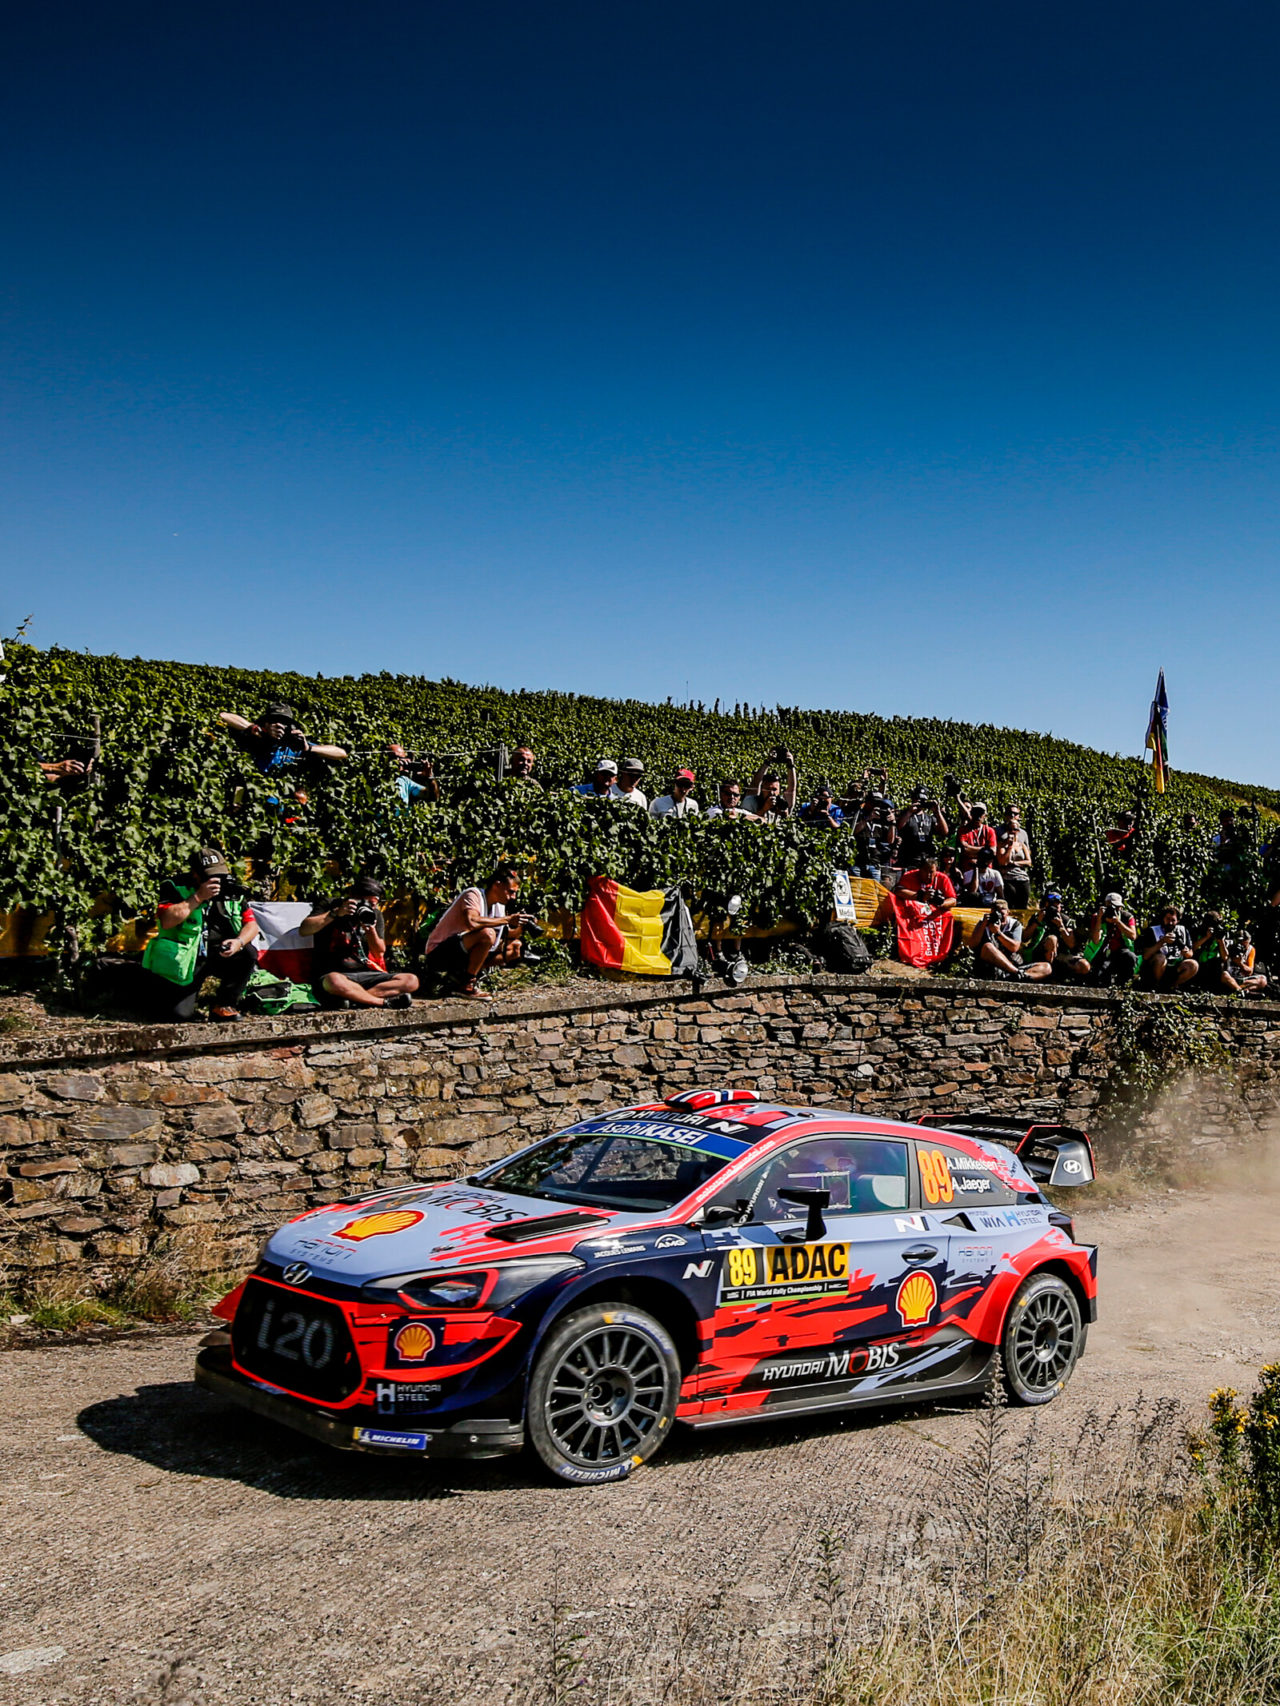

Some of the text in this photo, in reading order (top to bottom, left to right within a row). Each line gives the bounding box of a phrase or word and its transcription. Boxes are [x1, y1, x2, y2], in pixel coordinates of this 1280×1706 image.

[632, 1109, 708, 1126] HYUNDAI
[592, 1121, 708, 1146] AsahiKASEI
[946, 1157, 999, 1171] A.Mikkelsen
[917, 1149, 954, 1204] 89
[951, 1176, 991, 1193] A.Jaeger
[745, 1179, 765, 1214] HYUNDAI
[1020, 1217, 1042, 1226] STEEL
[728, 1243, 846, 1287] 89 ADAC
[787, 1283, 823, 1295] Championship
[256, 1299, 334, 1369] i20
[762, 1342, 900, 1381] HYUNDAI MOBIS
[397, 1384, 442, 1393] HYUNDAI
[397, 1393, 430, 1402] STEEL
[371, 1434, 421, 1445] MICHELIN
[561, 1465, 621, 1480] MICHELIN
